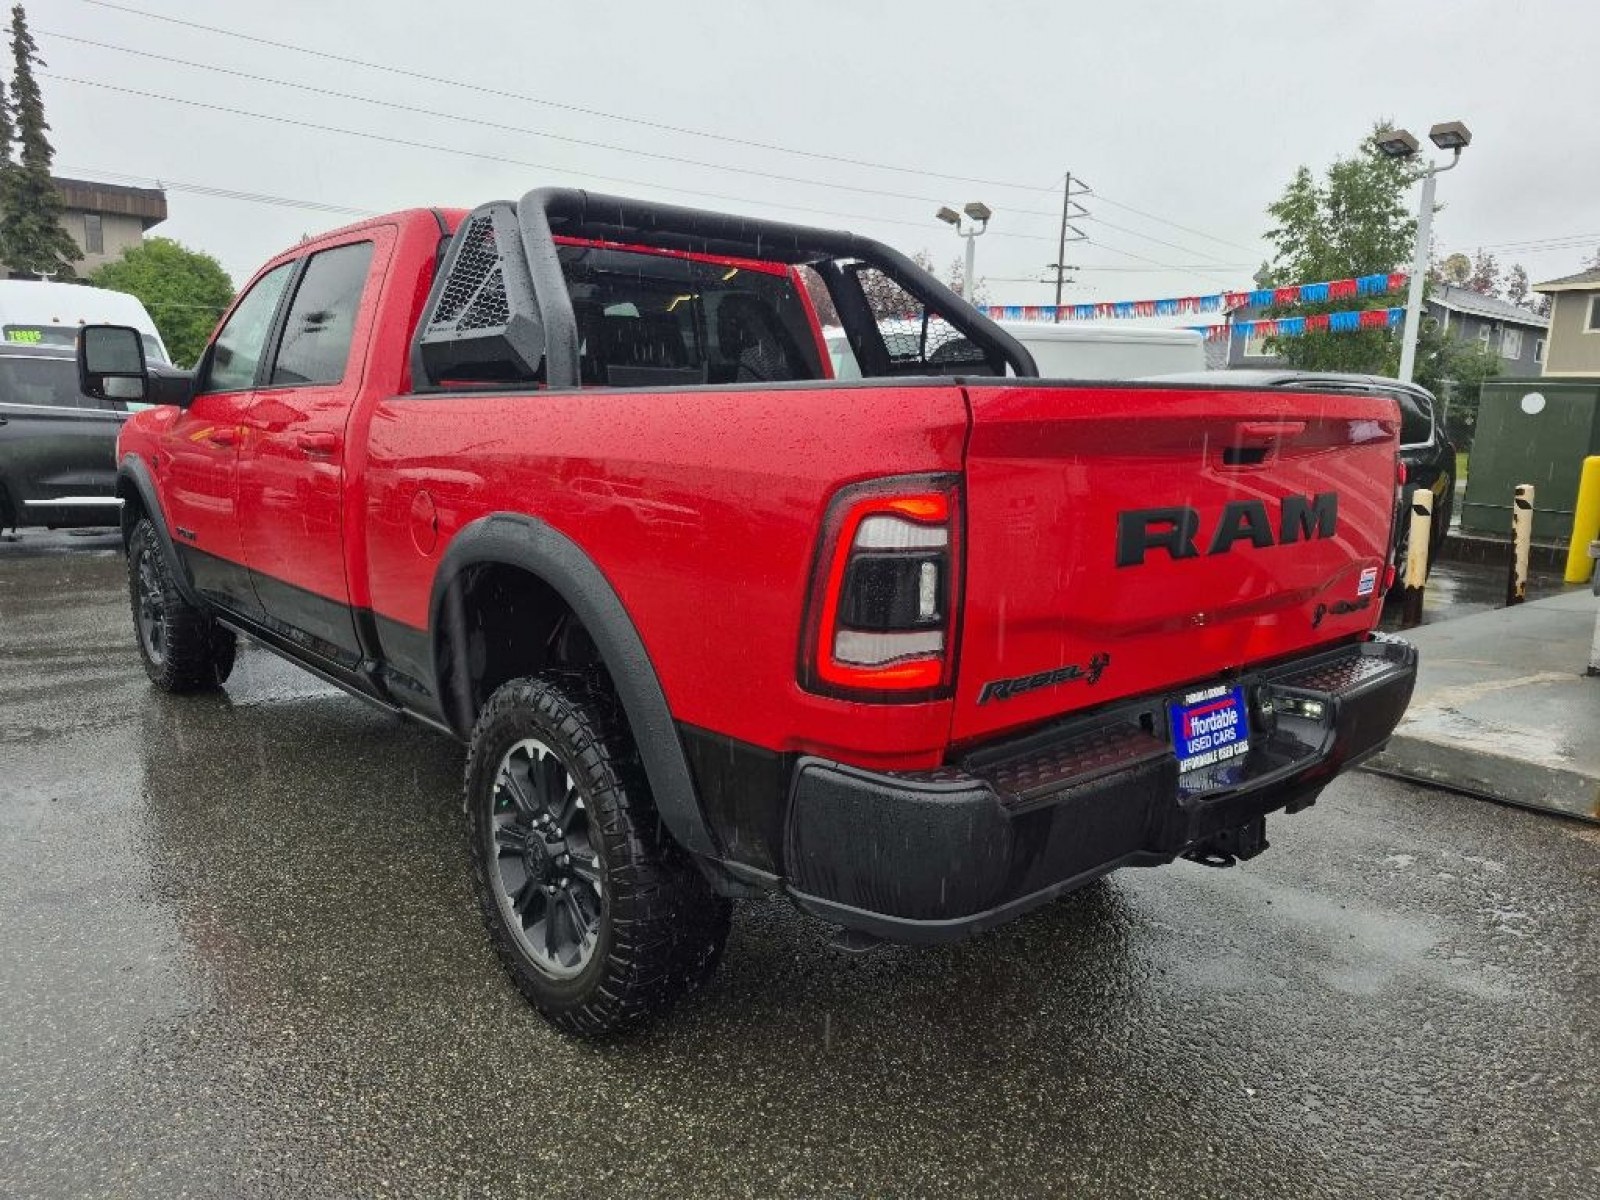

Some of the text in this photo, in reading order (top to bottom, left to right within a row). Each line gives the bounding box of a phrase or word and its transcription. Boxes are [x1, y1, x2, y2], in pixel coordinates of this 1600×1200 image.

[1117, 492, 1338, 567] RAM
[1188, 728, 1236, 753] USED CARS
